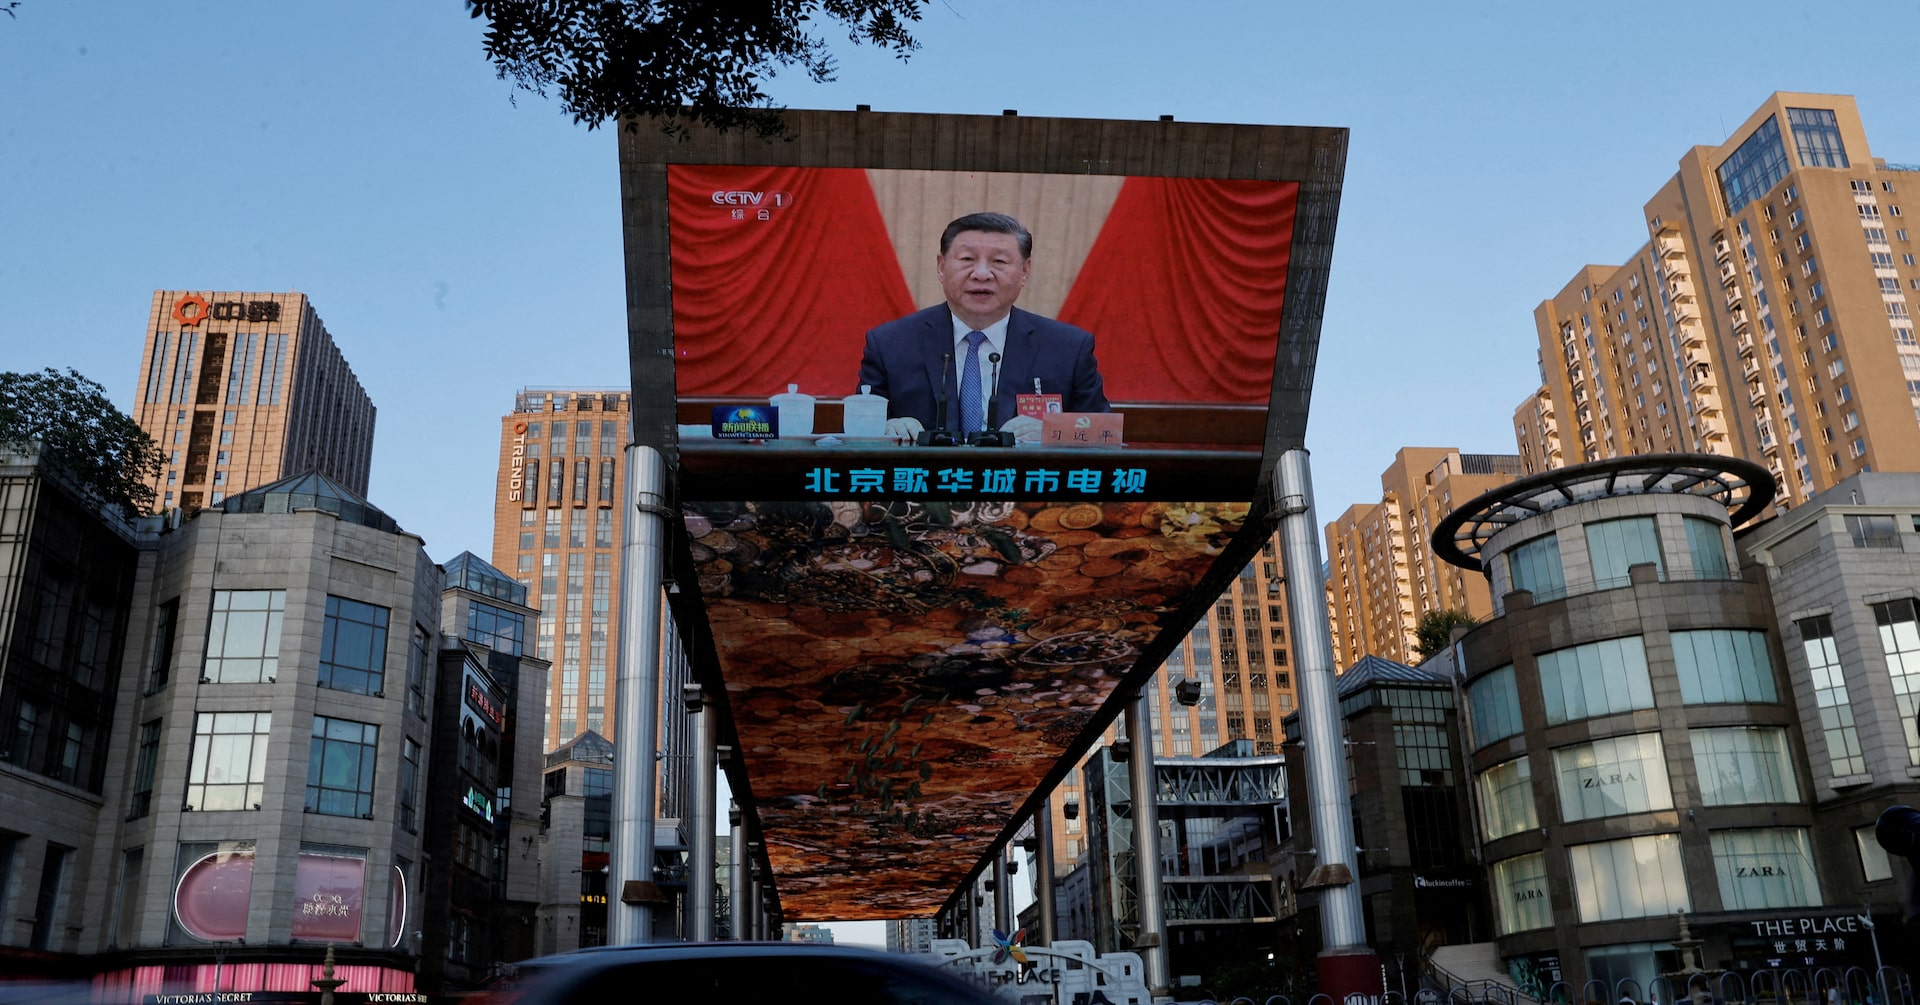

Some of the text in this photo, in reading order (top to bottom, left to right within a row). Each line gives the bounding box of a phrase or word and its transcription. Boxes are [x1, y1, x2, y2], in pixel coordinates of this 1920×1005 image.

[712, 191, 782, 206] CCTV 1
[731, 209, 769, 220] 综合
[722, 420, 769, 433] 新闻联播
[1052, 430, 1113, 442] 习近平
[509, 433, 525, 502] TRENDS
[805, 468, 1146, 493] 北京歌华城市电视
[1583, 772, 1638, 788] ZARA
[1735, 866, 1786, 877] ZARA
[1515, 889, 1544, 901] ZARA
[1751, 917, 1857, 936] THE PLACE
[1774, 938, 1845, 953] 世贸天阶
[1005, 968, 1061, 985] PLACE
[156, 993, 212, 1004] VICTORIA'S
[368, 993, 416, 1003] VICTORIA'S
